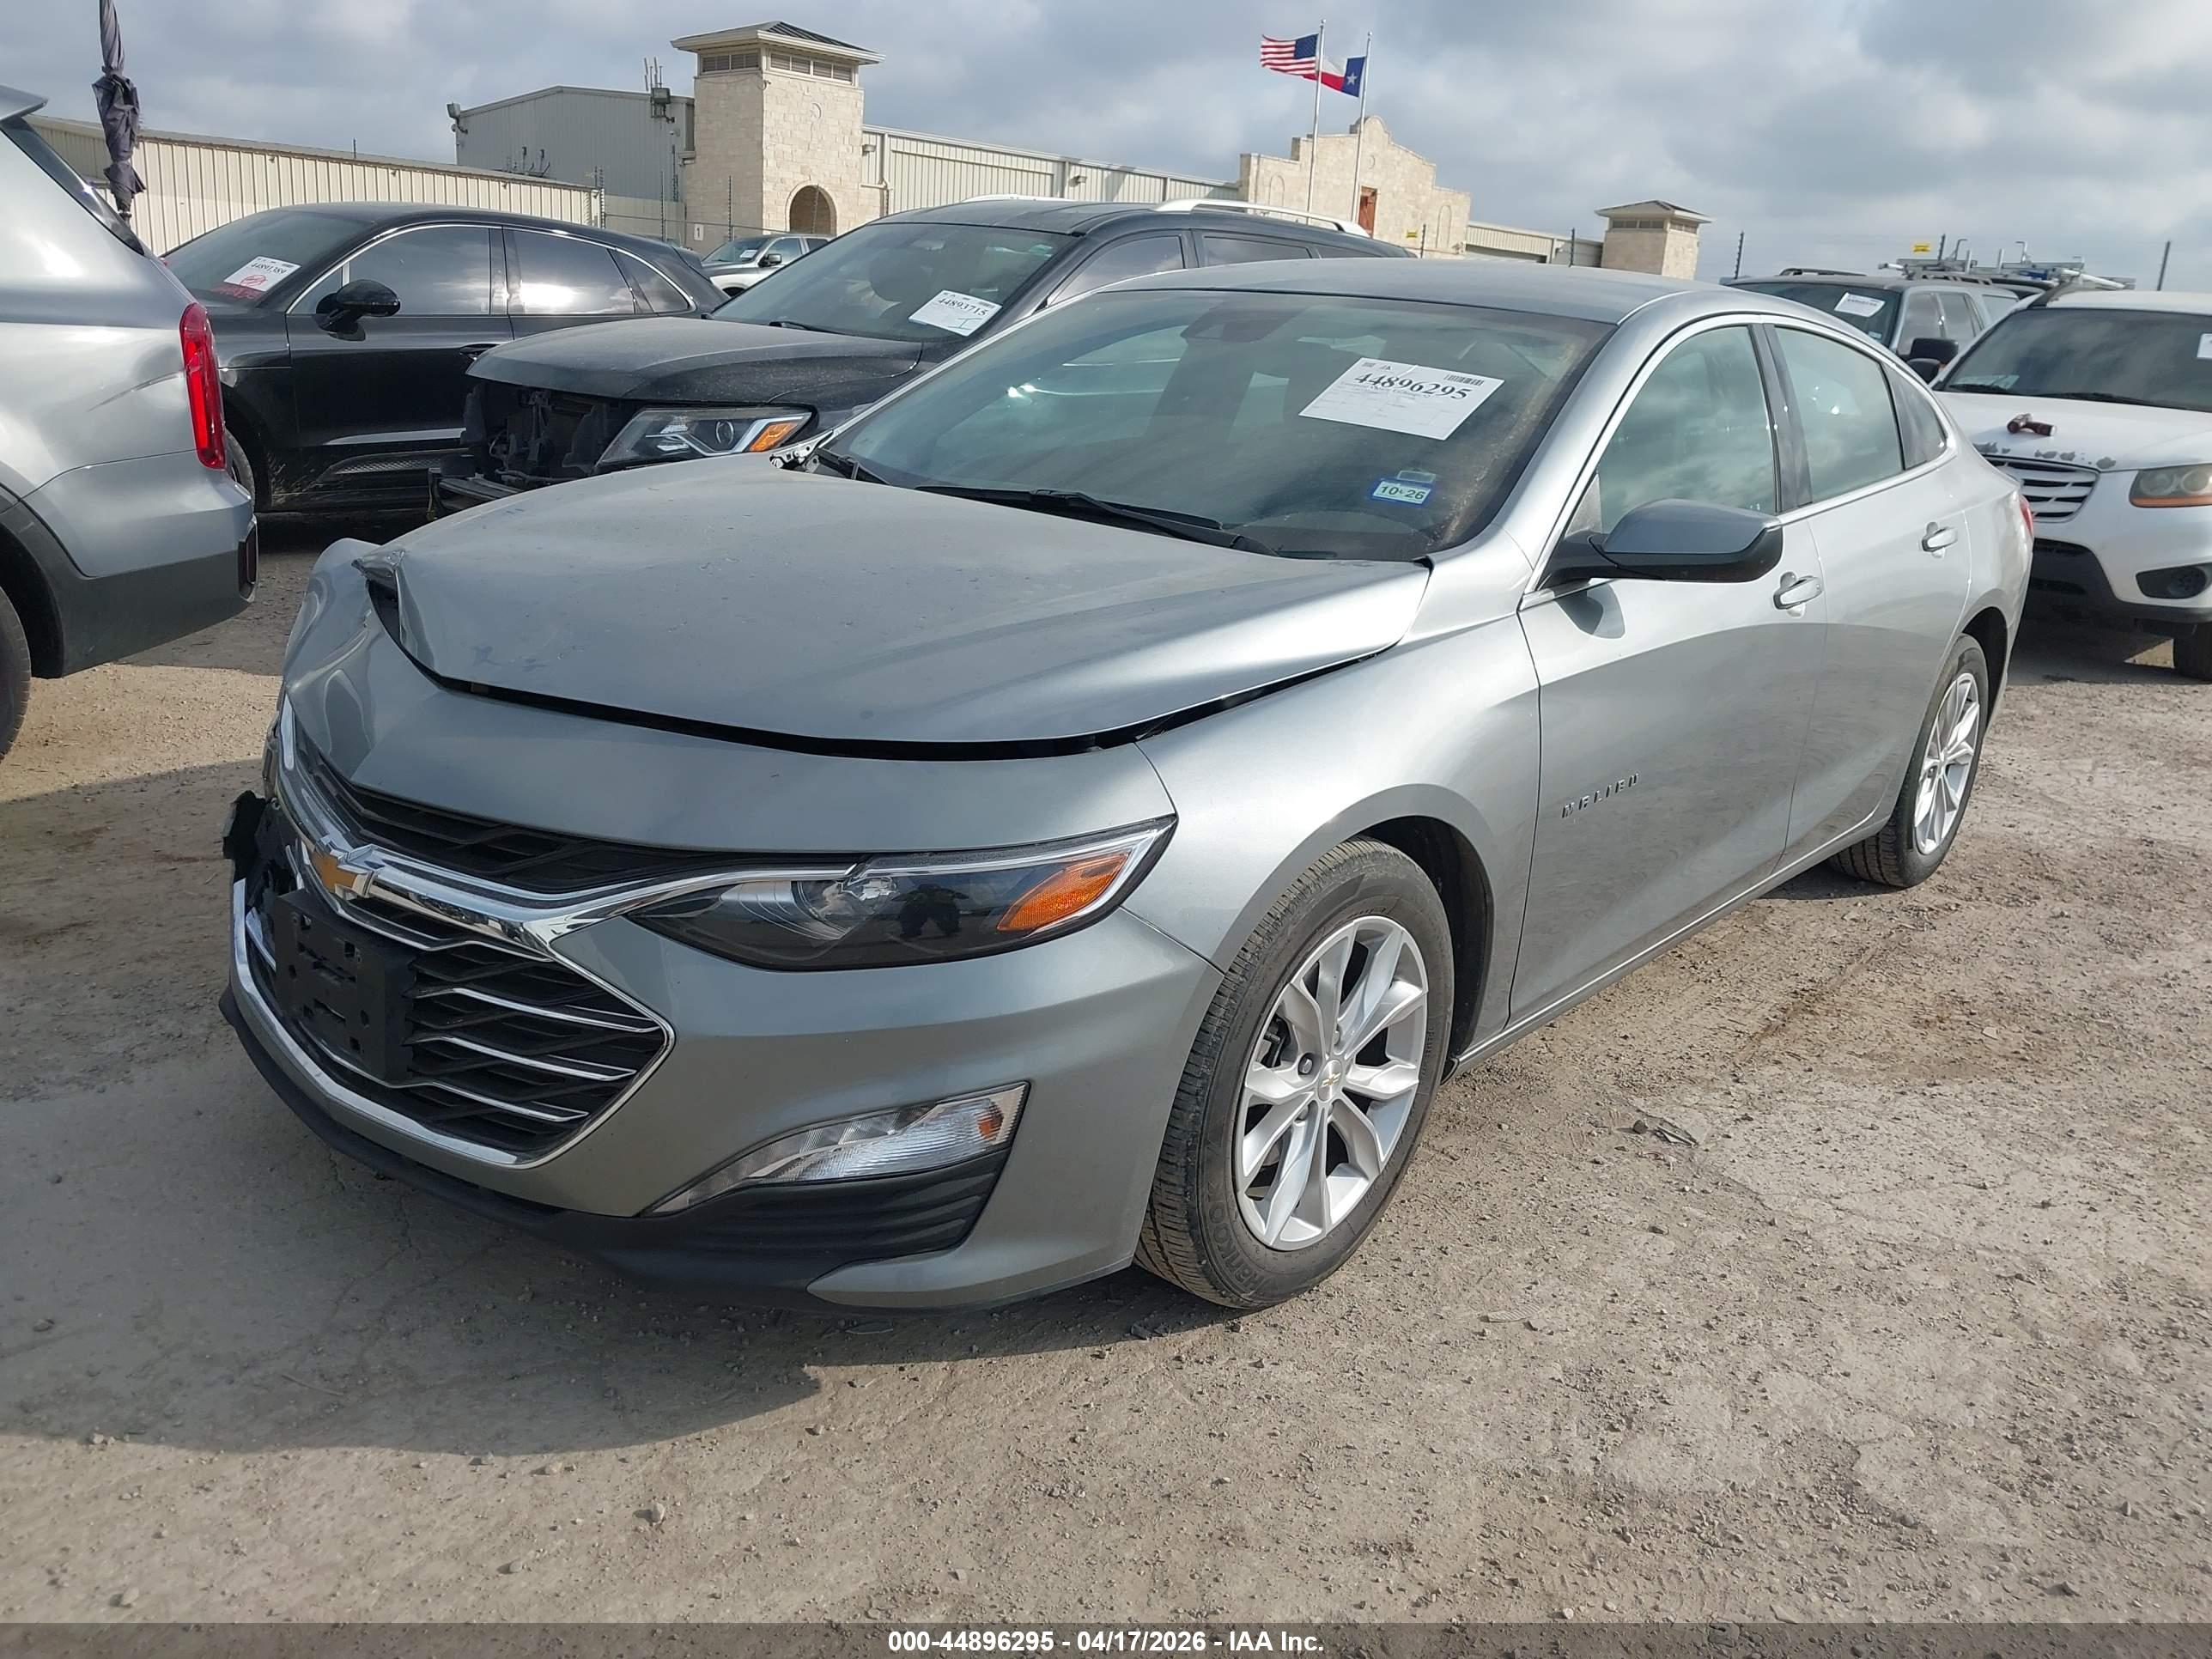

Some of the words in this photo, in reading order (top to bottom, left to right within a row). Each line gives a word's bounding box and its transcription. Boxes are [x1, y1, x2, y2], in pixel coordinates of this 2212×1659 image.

[939, 297, 988, 316] 44893715
[1355, 373, 1472, 399] 44896295
[1561, 772, 1639, 818] MALIBU
